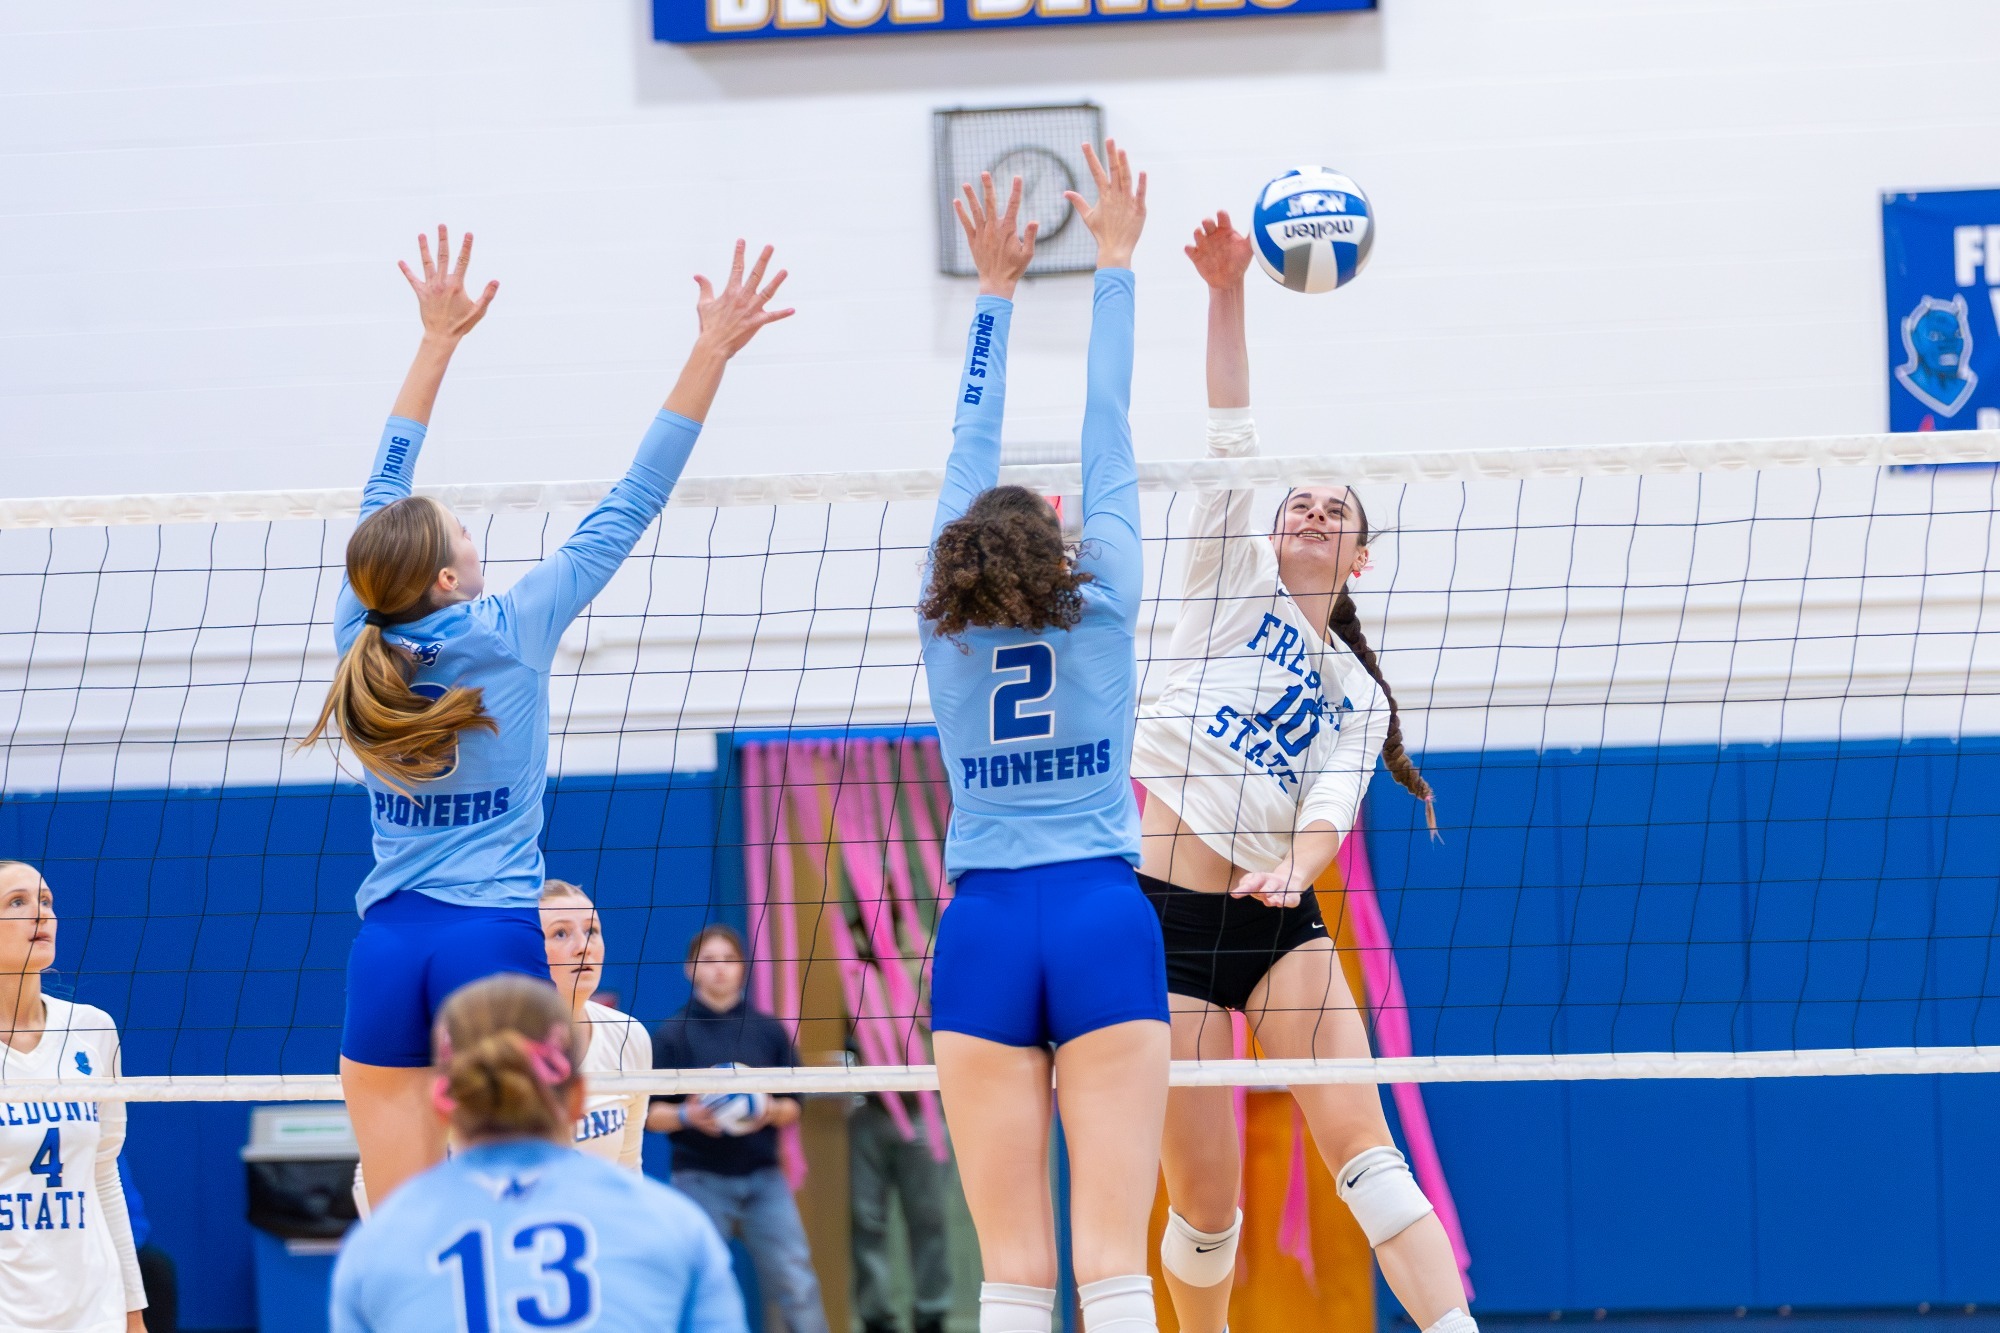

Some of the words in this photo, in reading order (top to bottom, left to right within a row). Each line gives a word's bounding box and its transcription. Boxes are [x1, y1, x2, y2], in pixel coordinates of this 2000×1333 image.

[1284, 219, 1353, 239] molten
[970, 313, 994, 378] STRONG
[964, 383, 983, 405] OX
[990, 641, 1056, 744] 2
[1254, 684, 1320, 757] 10
[960, 739, 1110, 789] PIONEERS
[1207, 705, 1298, 794] STAT
[375, 787, 510, 826] PIONEERS
[30, 1127, 63, 1188] 4
[433, 1217, 597, 1333] 13
